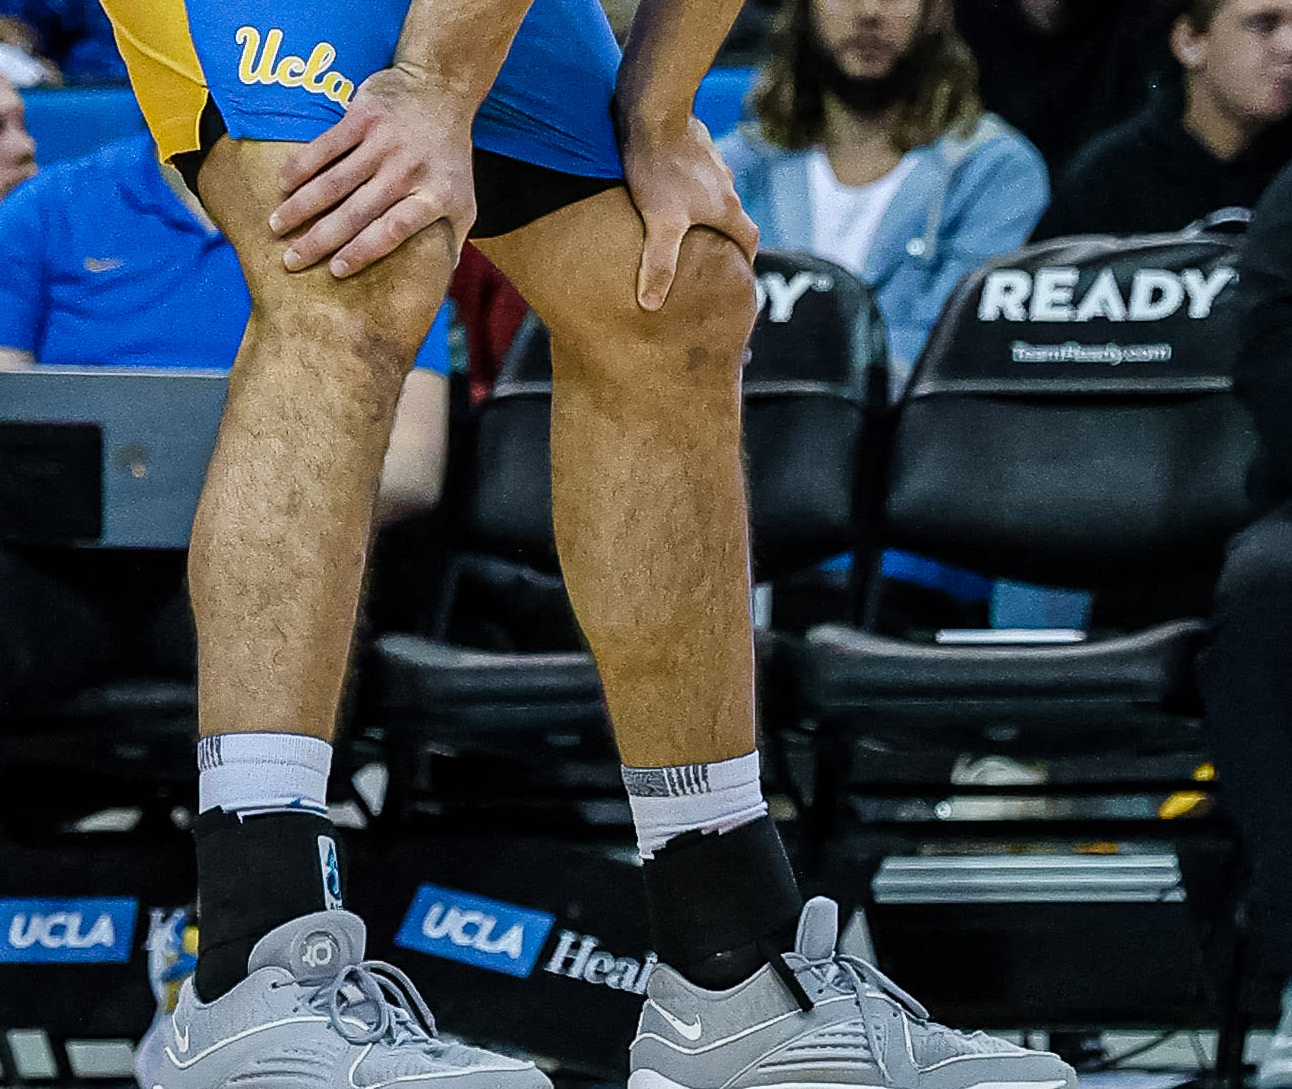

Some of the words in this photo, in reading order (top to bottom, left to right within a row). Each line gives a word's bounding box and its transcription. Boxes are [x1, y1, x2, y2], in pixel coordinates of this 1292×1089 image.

[235, 26, 355, 110] Ucla
[977, 267, 1237, 321] READY
[9, 912, 115, 948] UCLA
[422, 903, 525, 960] UCLA
[543, 929, 658, 995] Heal
